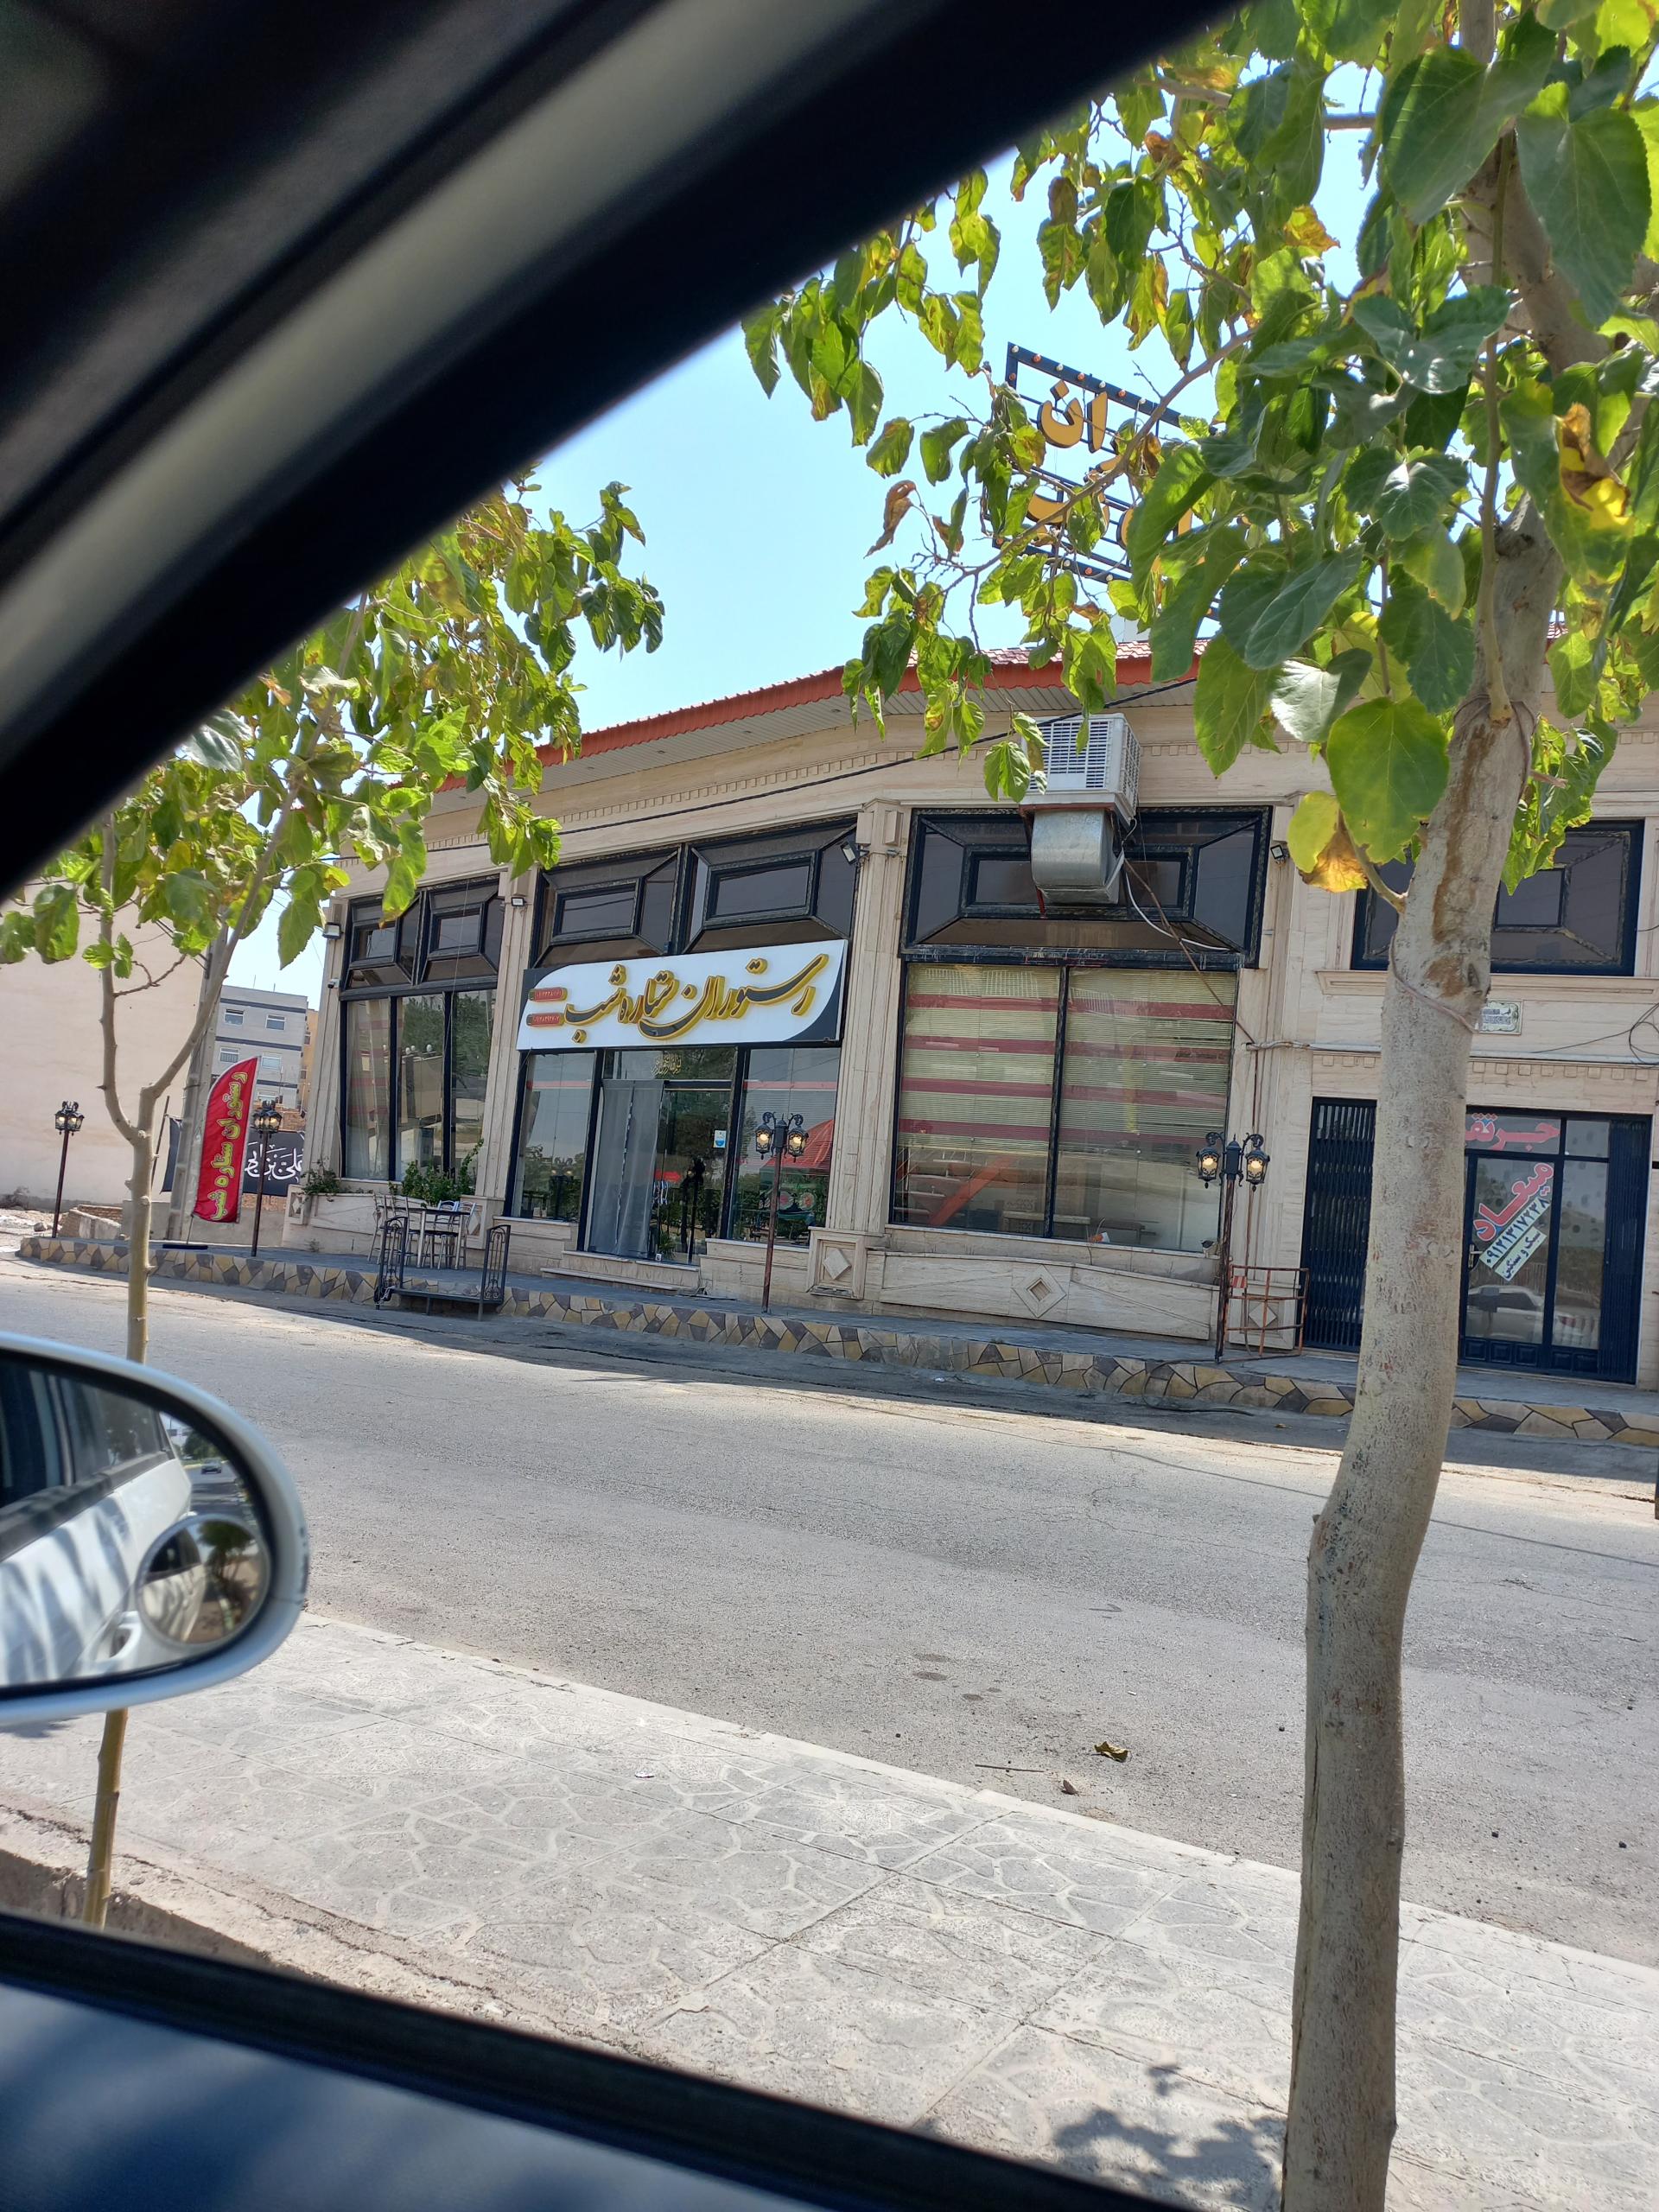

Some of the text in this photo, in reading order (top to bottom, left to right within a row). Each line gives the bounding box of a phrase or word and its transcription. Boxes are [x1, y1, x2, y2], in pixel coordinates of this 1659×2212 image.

[563, 953, 830, 1044] رستوران ستاره شب
[207, 1071, 248, 1221] رستوران ستاره شب
[1473, 1163, 1554, 1241] میعاد
